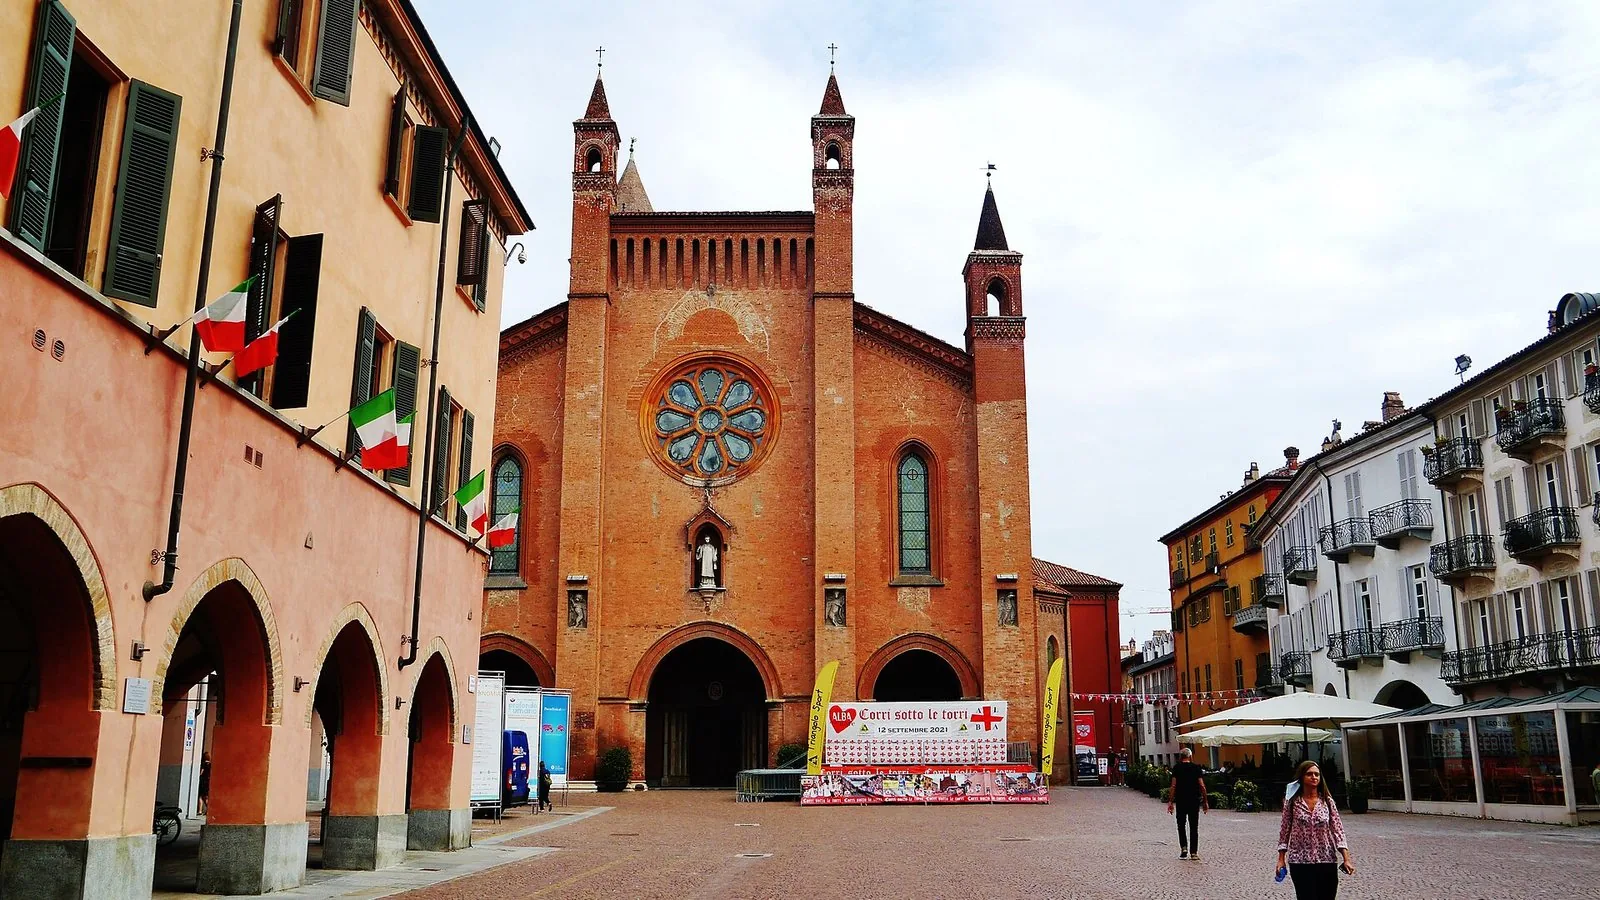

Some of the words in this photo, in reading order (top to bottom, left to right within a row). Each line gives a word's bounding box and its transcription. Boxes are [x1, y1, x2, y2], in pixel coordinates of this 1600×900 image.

[813, 688, 823, 711] Sport
[1045, 687, 1053, 710] Sport
[832, 711, 852, 721] ALBA
[859, 708, 891, 720] Corri
[894, 709, 923, 720] sotto
[928, 708, 938, 720] le
[942, 708, 968, 720] torri
